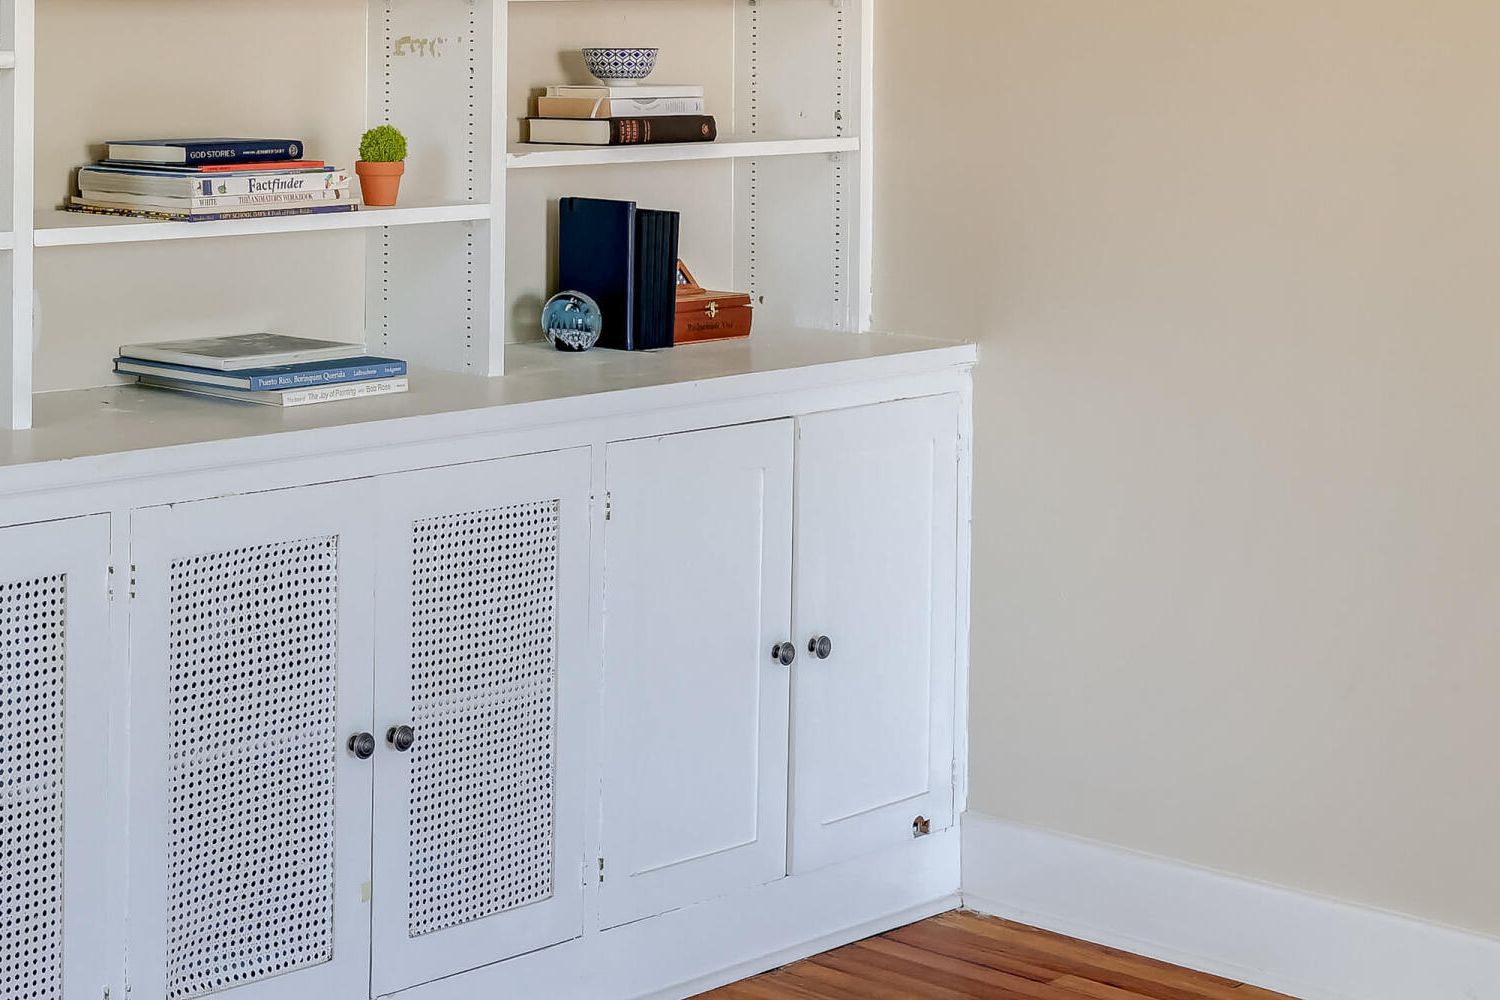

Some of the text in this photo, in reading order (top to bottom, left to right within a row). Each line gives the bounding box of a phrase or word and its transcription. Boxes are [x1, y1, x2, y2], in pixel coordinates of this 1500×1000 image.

[190, 151, 205, 159] GOD
[206, 150, 236, 159] STORIES
[248, 176, 304, 193] Factfinder
[199, 198, 217, 206] WHITE
[258, 371, 346, 387] Puerto Rico, Borinquen Querida
[308, 392, 318, 400] The
[319, 391, 329, 400] Joy
[329, 391, 335, 399] of
[335, 387, 356, 396] Painting
